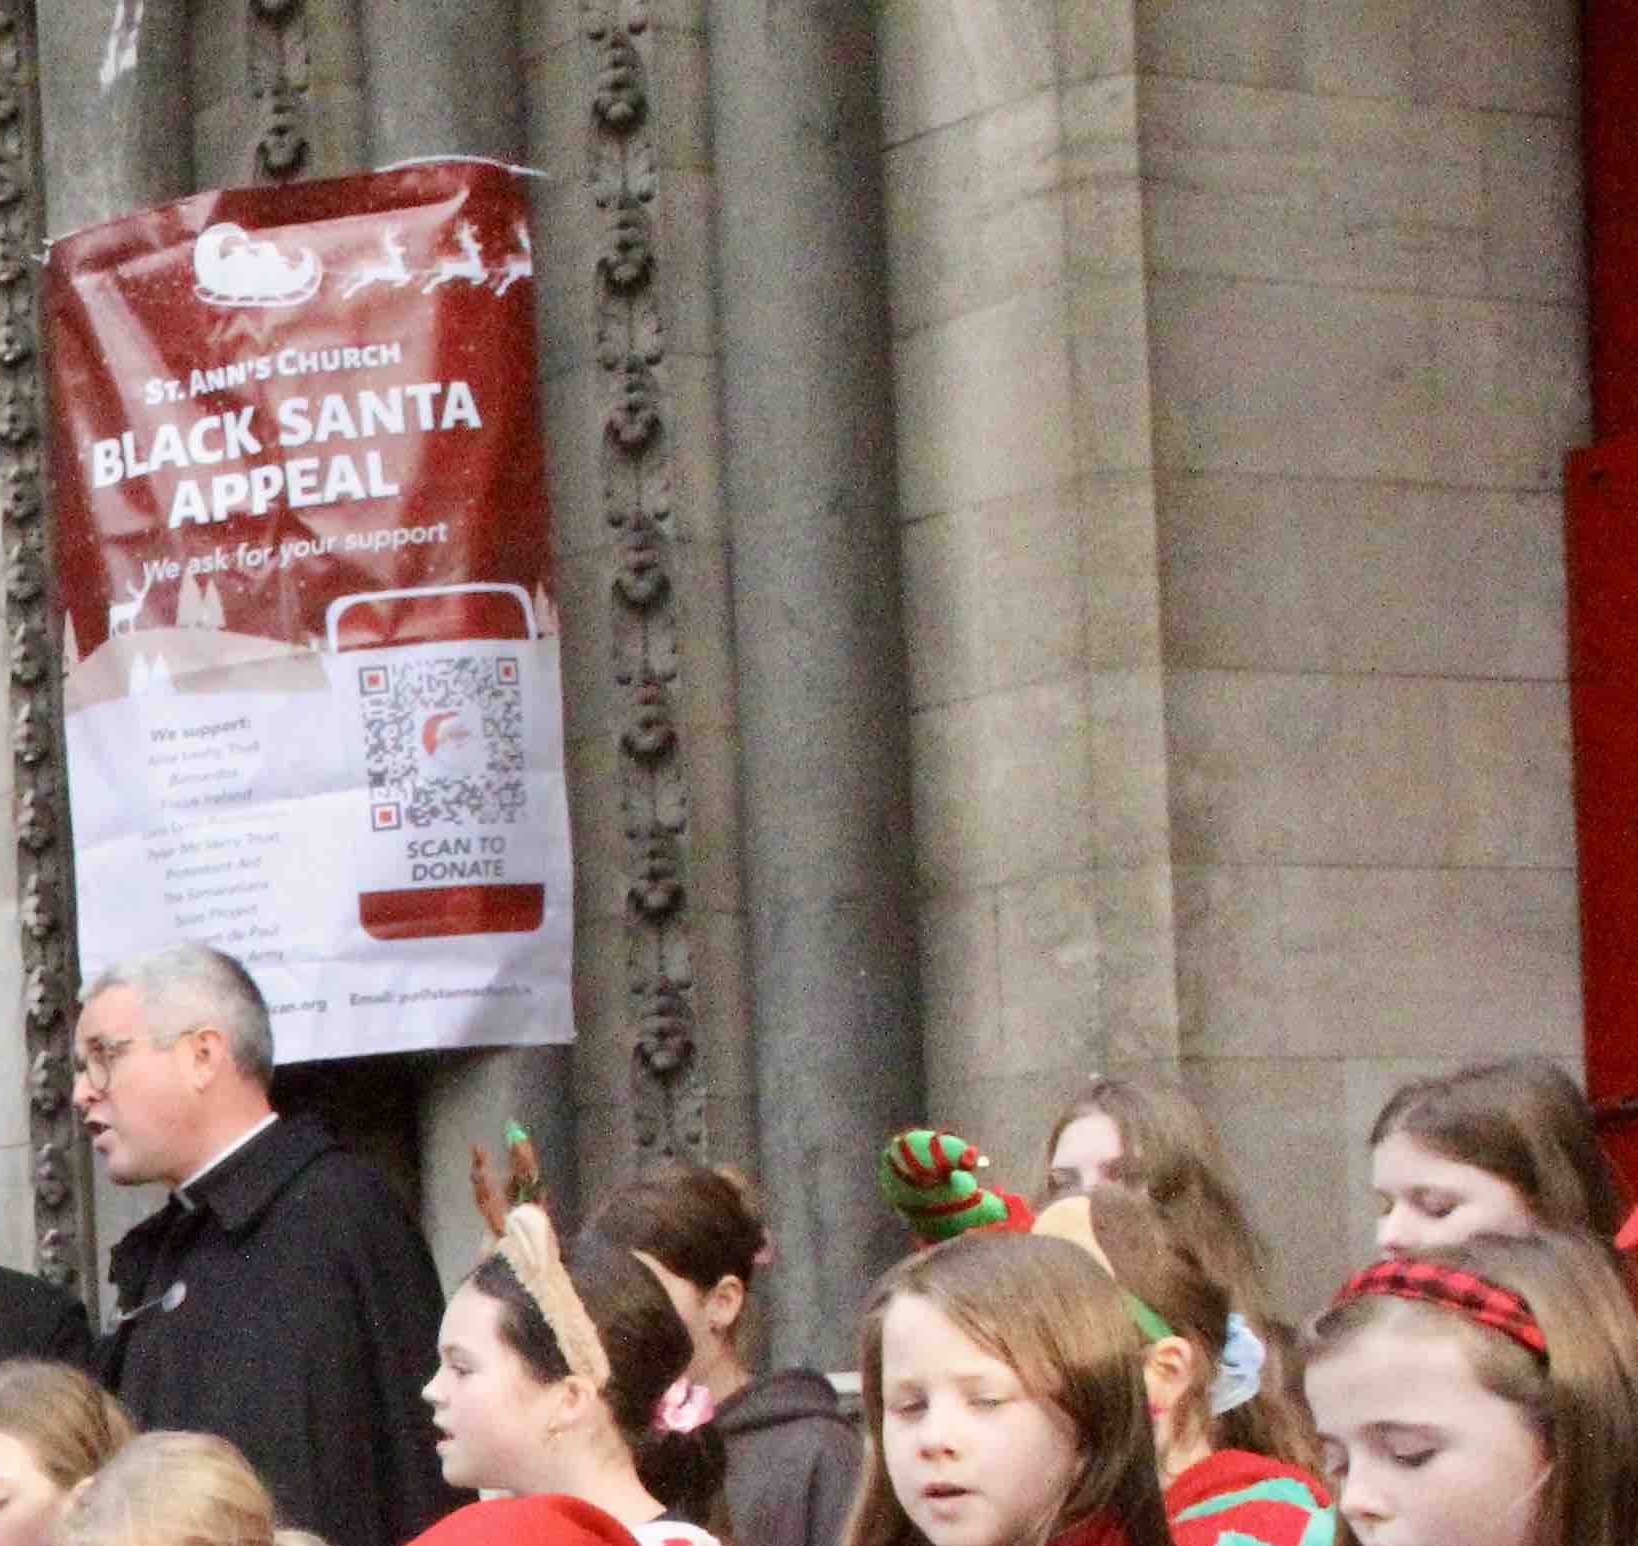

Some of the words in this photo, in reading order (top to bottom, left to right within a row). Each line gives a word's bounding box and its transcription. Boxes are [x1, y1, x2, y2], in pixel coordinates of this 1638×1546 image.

[189, 357, 272, 398] ANN'S
[277, 342, 402, 379] CHURCH
[91, 406, 262, 489] BLACK
[277, 381, 483, 449] SANTA
[168, 450, 401, 529] APPEAL
[143, 557, 180, 582] We
[185, 549, 230, 576] ask
[235, 543, 273, 570] for
[278, 533, 338, 568] your
[344, 520, 449, 560] support
[407, 838, 471, 860] SCAN
[481, 836, 506, 854] TO
[411, 859, 503, 882] DONATE
